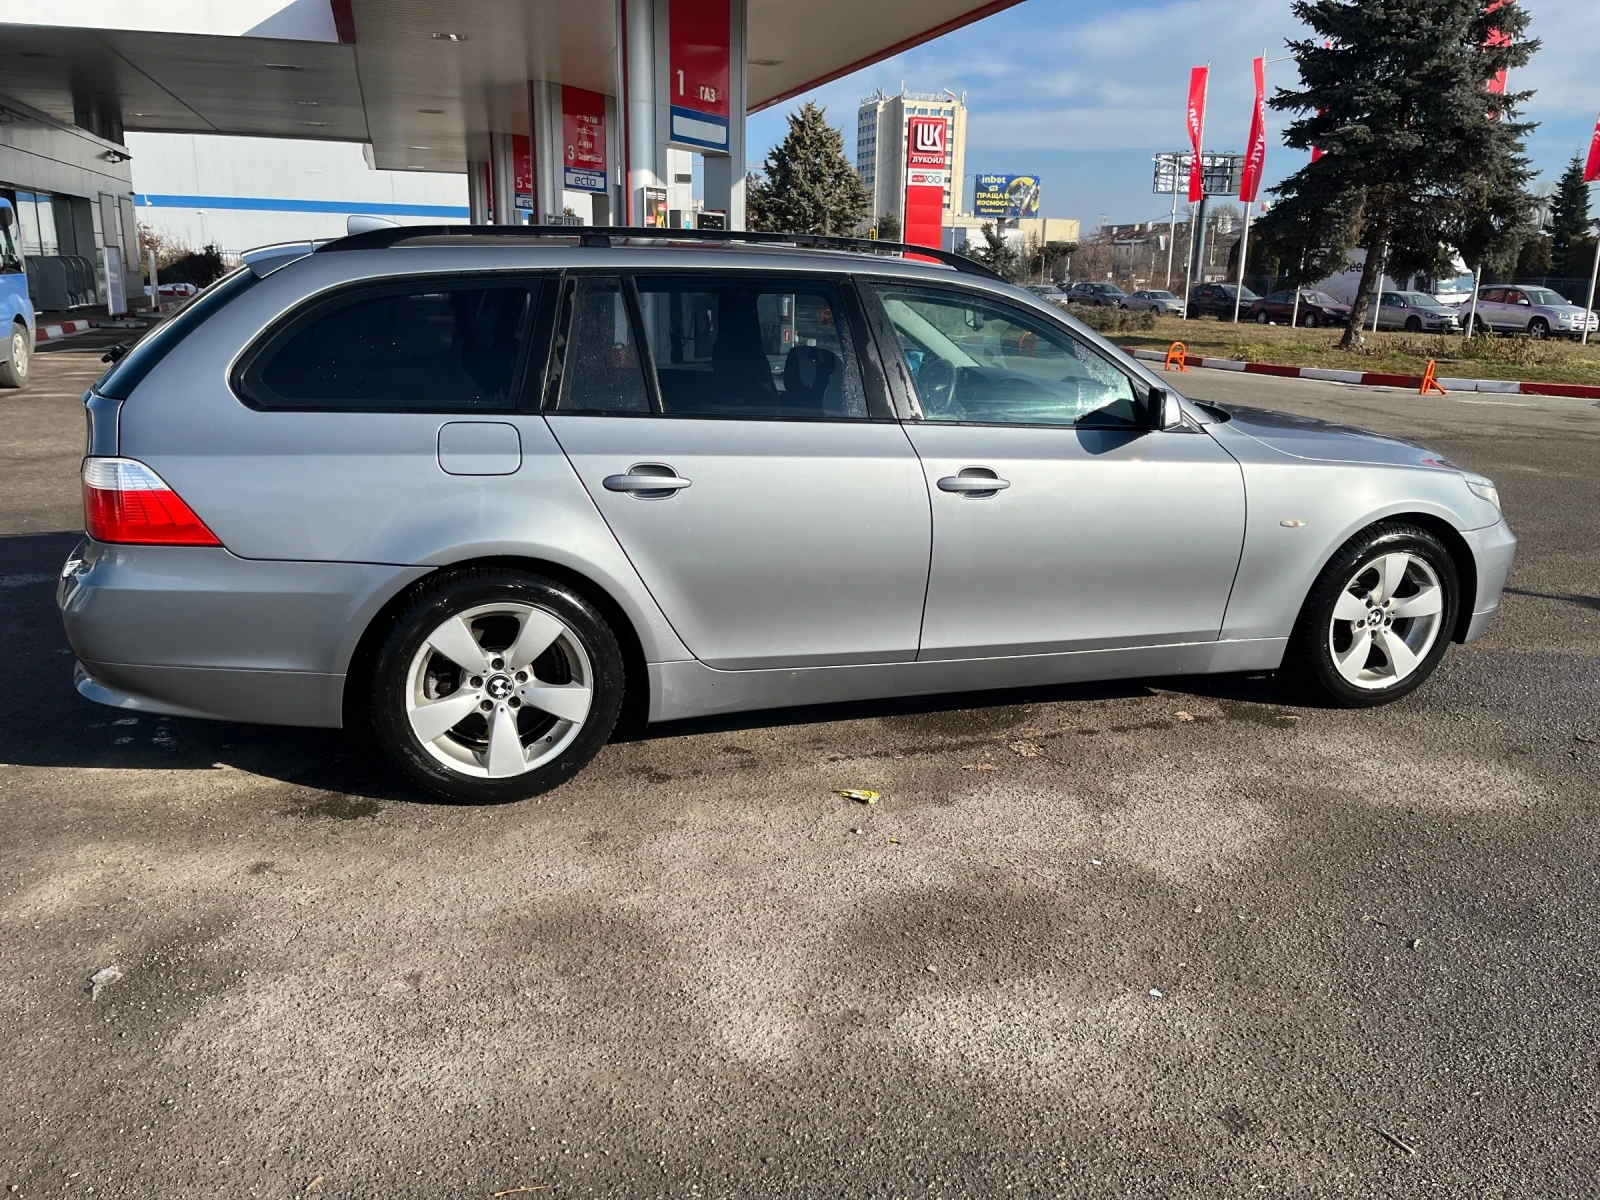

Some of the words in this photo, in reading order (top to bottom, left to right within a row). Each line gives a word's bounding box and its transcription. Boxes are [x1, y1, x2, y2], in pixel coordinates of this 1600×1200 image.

[677, 69, 684, 96] 1
[700, 85, 716, 103] ГАЗ
[567, 144, 575, 160] 3
[911, 155, 944, 165] ЛУКОЙЛ
[516, 177, 523, 189] 5
[574, 175, 597, 187] ecto
[977, 192, 1004, 200] ПРАЩА
[522, 199, 533, 207] ec
